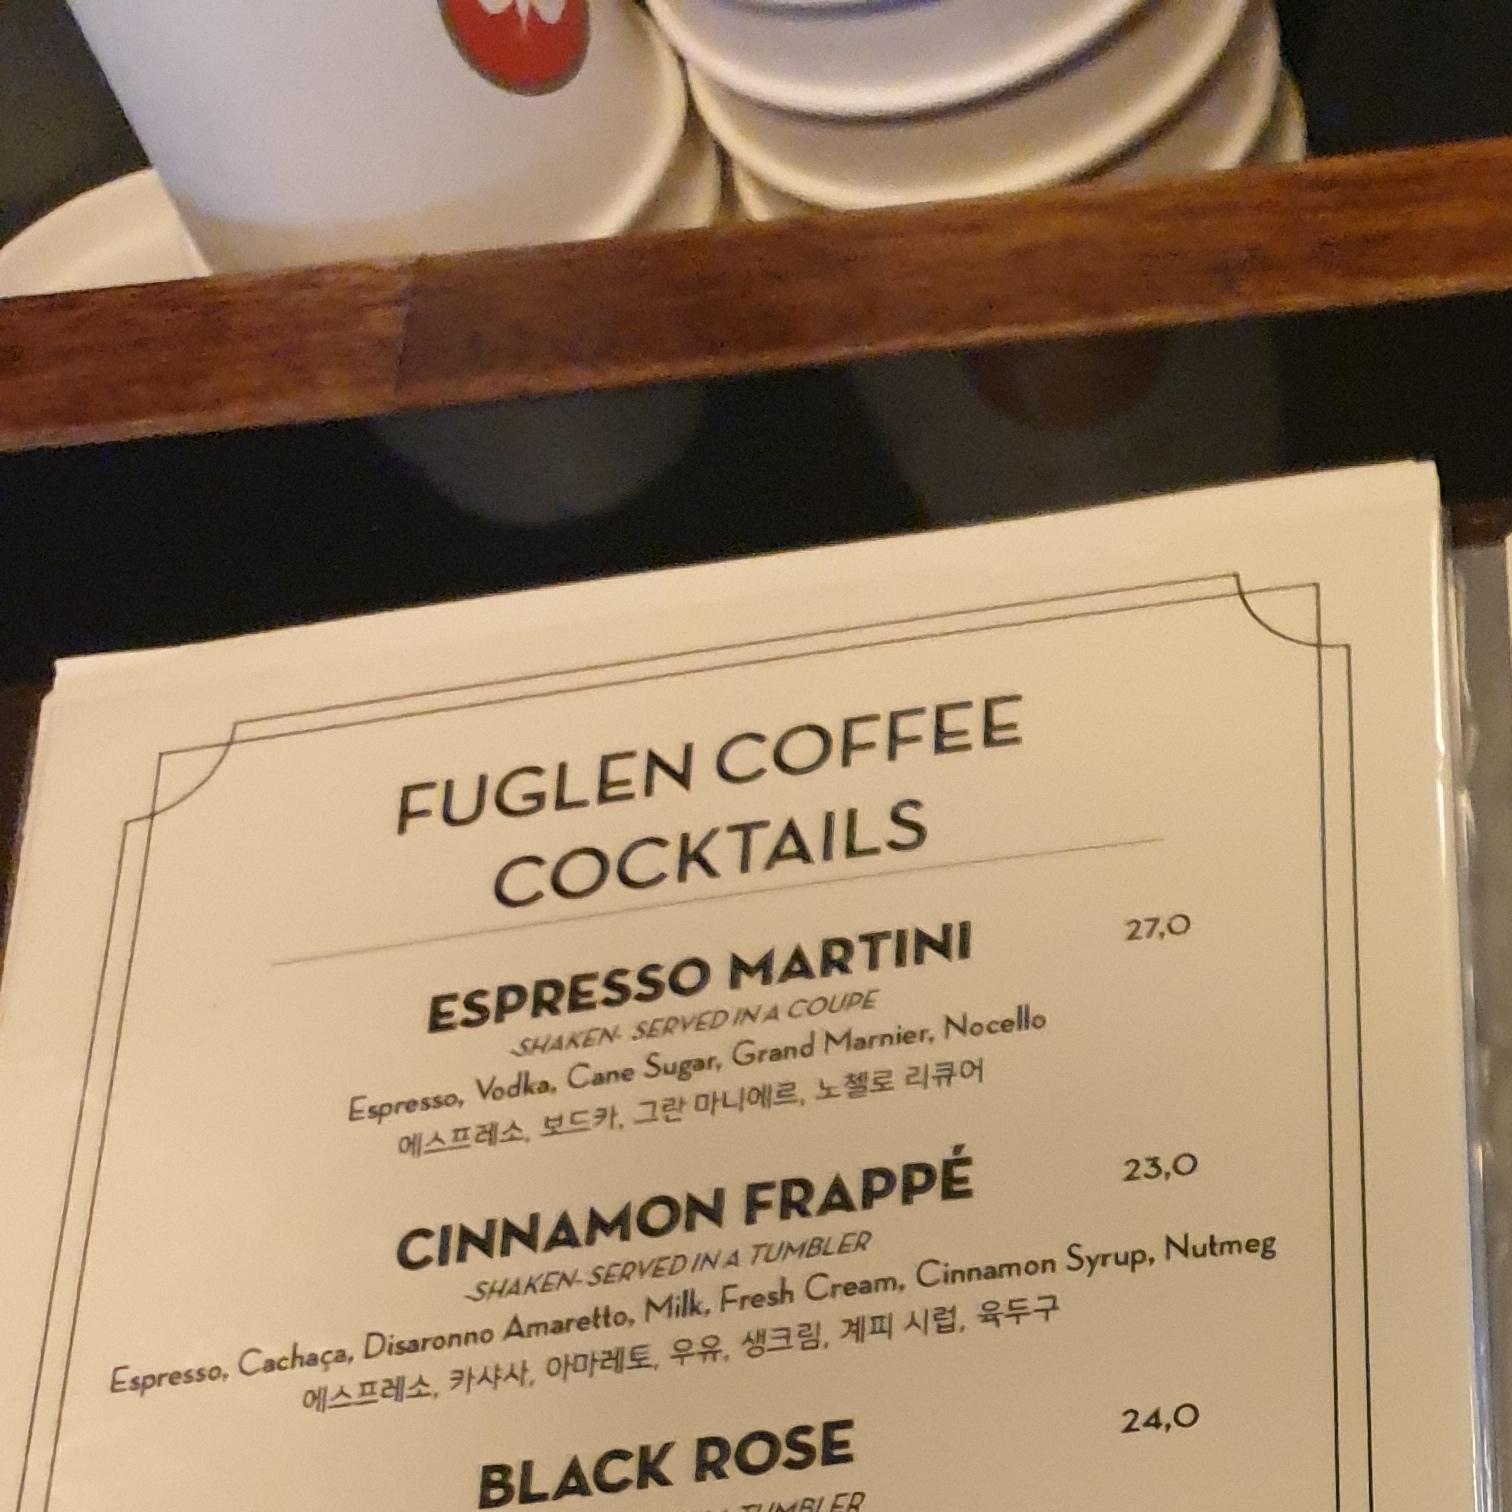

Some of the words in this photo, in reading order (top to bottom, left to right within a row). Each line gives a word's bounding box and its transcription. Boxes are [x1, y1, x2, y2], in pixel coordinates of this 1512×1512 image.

[397, 742, 694, 836] FUGLEN
[715, 694, 1022, 785] COFFEE
[493, 798, 927, 908] COCKTAILS
[427, 957, 711, 1034] ESPRESSO
[729, 920, 971, 990] MARTINI
[348, 1093, 464, 1124] Espresso,
[476, 1071, 557, 1100] Vodka,
[567, 1062, 635, 1089] Cane
[644, 1052, 721, 1081] Sugar,
[732, 1031, 815, 1066] Grand
[824, 1025, 934, 1054] Marnier,
[944, 1004, 1046, 1039] Nocello
[396, 1187, 725, 1271] CINNAMON
[744, 1144, 973, 1226] FRAPPÉ
[110, 1365, 228, 1396] Espresso,
[238, 1342, 354, 1376] Cachaça,
[364, 1329, 494, 1359] Disaronno
[503, 1305, 635, 1340] Amaretto,
[645, 1288, 710, 1322] Milk,
[720, 1276, 794, 1312] Fresh
[804, 1272, 905, 1301] Cream,
[916, 1258, 1056, 1287] Cinnamon
[1066, 1243, 1155, 1277] Syrup,
[1165, 1233, 1276, 1261] Nutmeg
[478, 1441, 676, 1510] BLACK
[694, 1419, 854, 1483] ROSE
